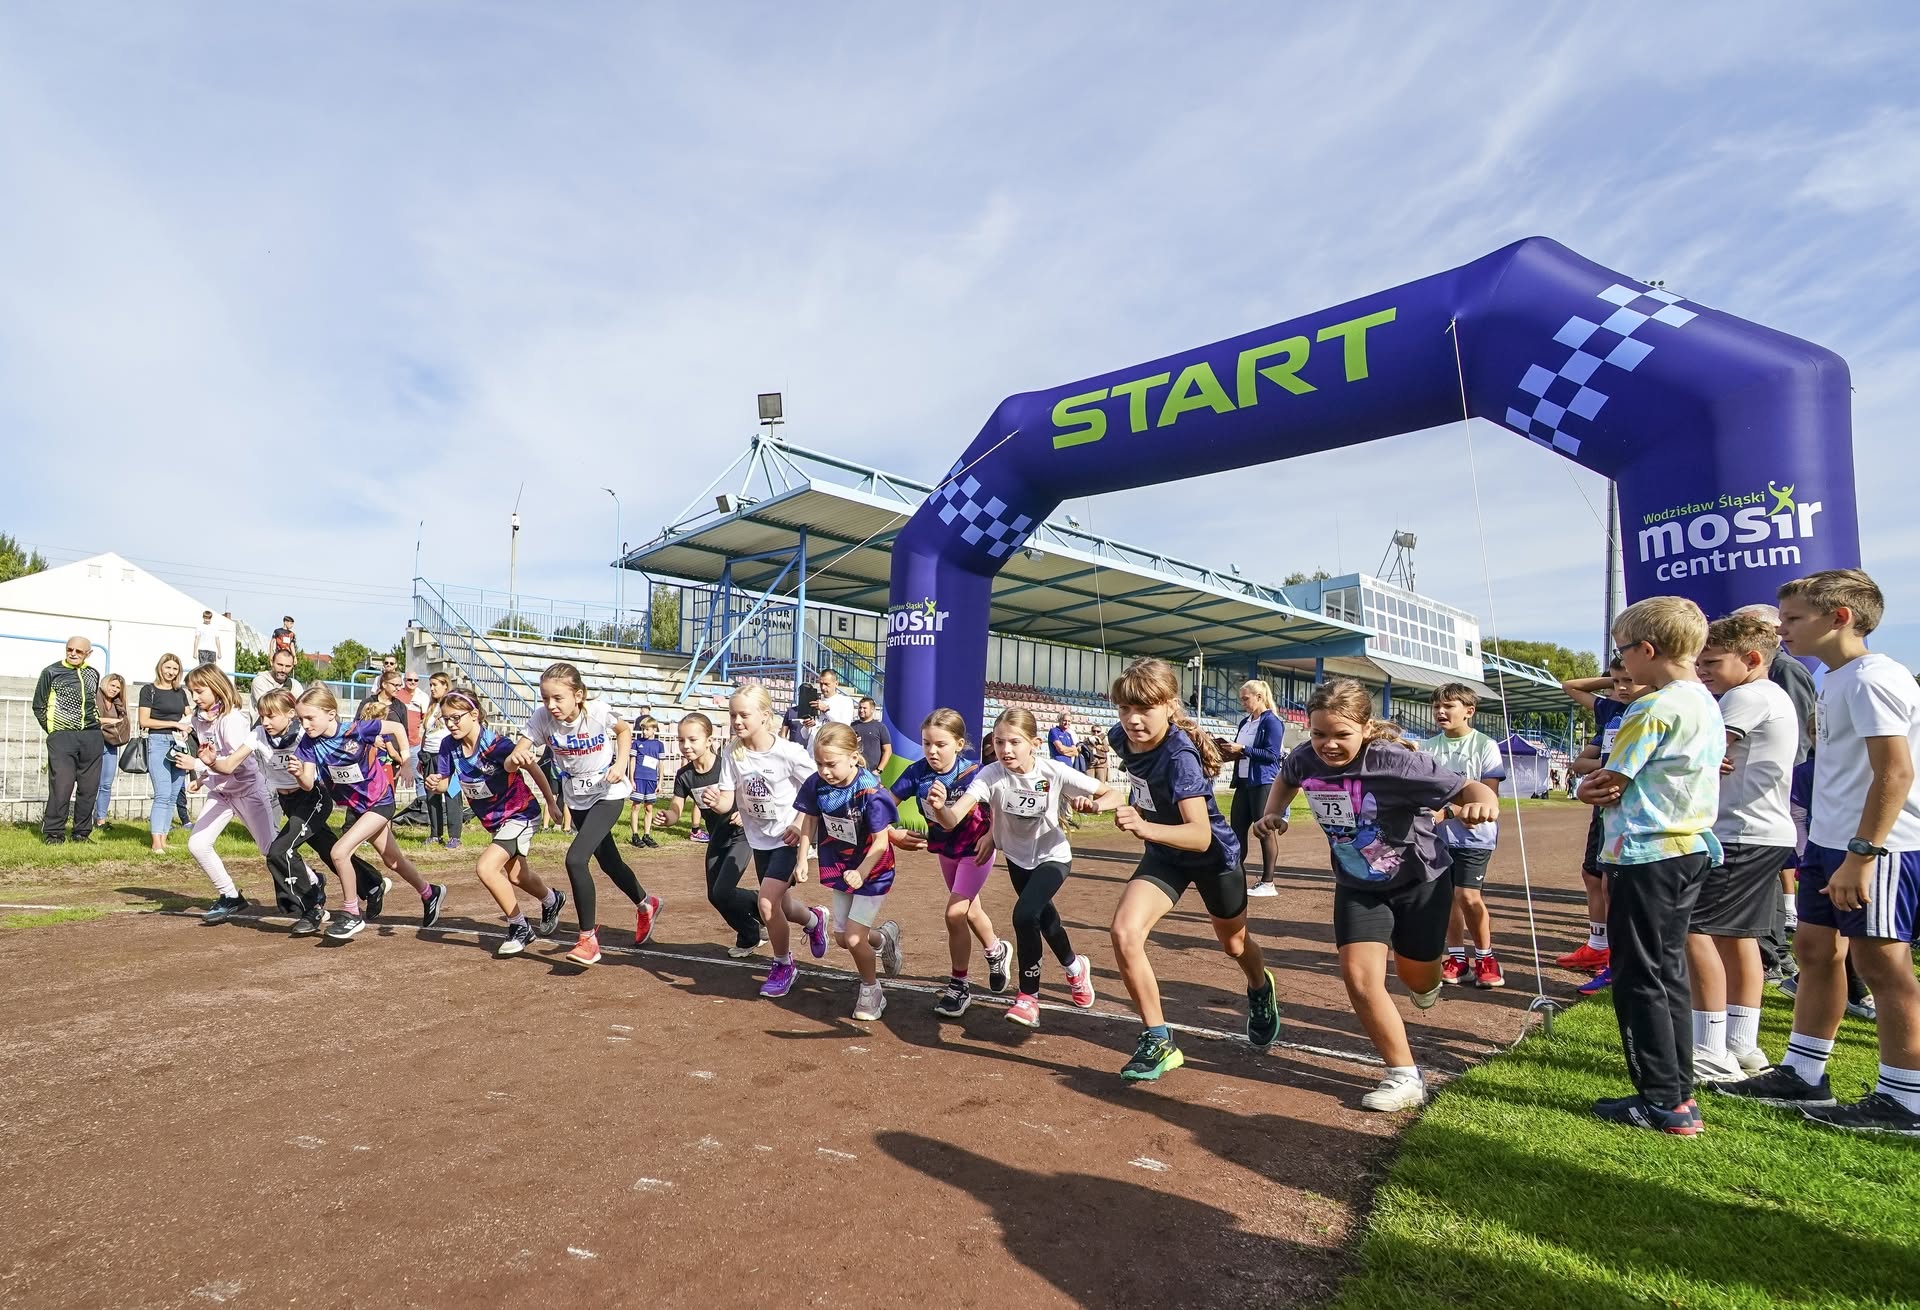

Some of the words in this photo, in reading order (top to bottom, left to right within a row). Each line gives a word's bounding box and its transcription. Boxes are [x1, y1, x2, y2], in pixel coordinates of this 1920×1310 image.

[1051, 307, 1396, 450] START
[1643, 501, 1714, 525] Wodzisław
[1718, 491, 1766, 508] Śląski
[1638, 501, 1822, 562] mosir
[1656, 545, 1801, 582] centrum
[742, 615, 792, 630] ODZINNY
[838, 618, 848, 632] E
[887, 632, 935, 648] centrum
[336, 771, 350, 779] 80
[578, 778, 593, 788] 76
[752, 803, 766, 813] 81
[1019, 796, 1036, 808] 79
[1321, 802, 1342, 816] 73
[830, 822, 845, 834] 84
